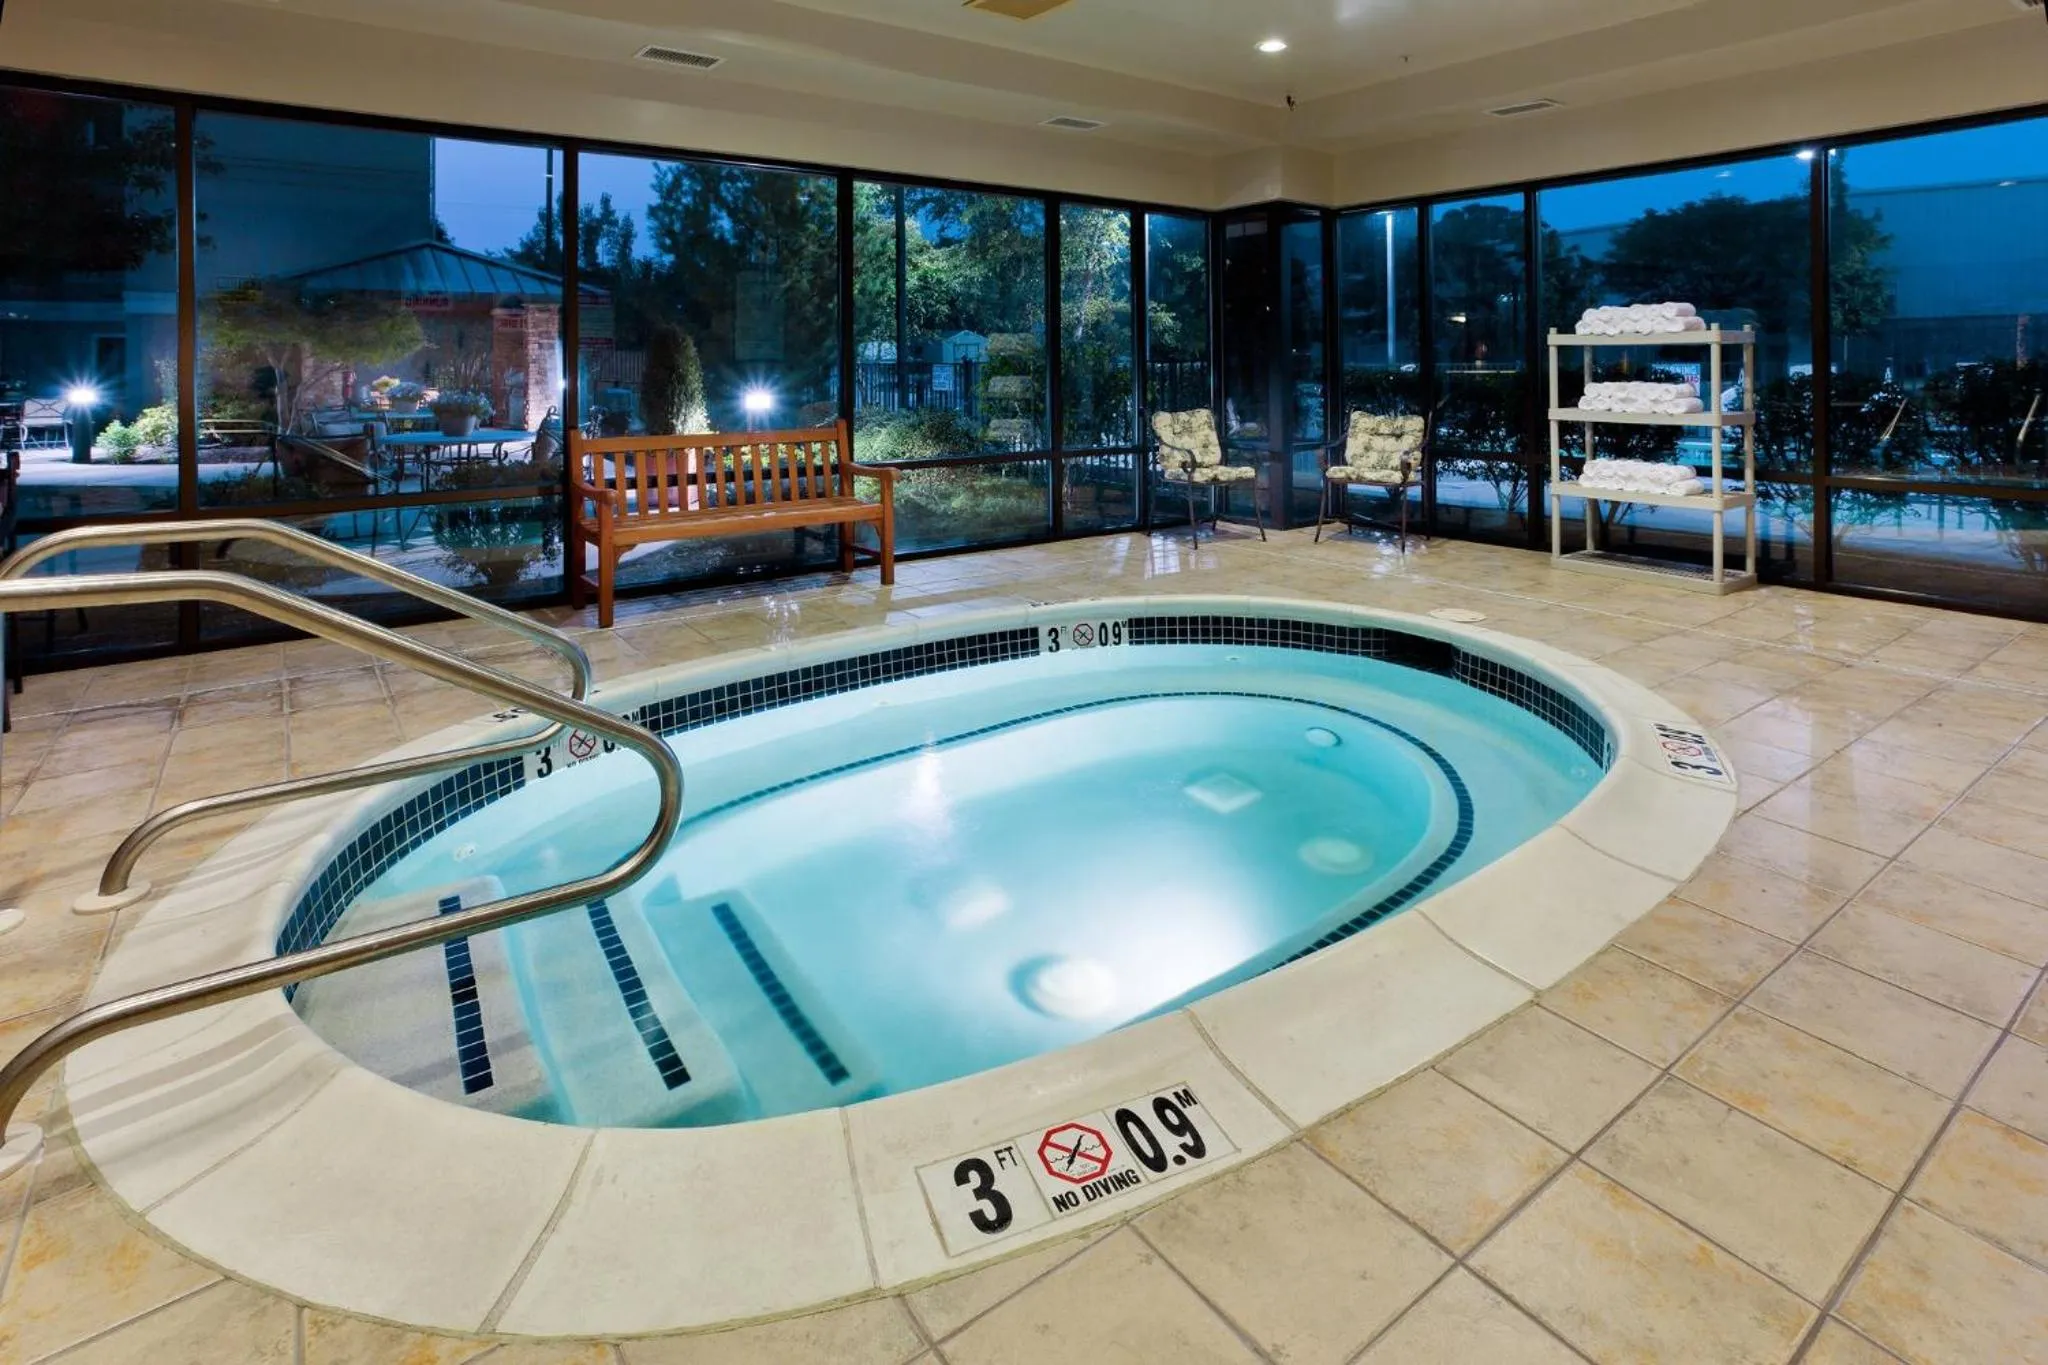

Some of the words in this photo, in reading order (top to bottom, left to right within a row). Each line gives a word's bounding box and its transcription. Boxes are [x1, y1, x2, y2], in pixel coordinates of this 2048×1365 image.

[1048, 627, 1060, 652] 3
[1099, 621, 1121, 646] 0.9
[536, 746, 552, 778] 3
[1114, 1096, 1207, 1173] 0.9
[1174, 1088, 1198, 1109] M
[954, 1158, 1013, 1235] 3
[994, 1146, 1018, 1170] FT
[1052, 1191, 1080, 1214] NO
[1084, 1168, 1141, 1202] DIVING
